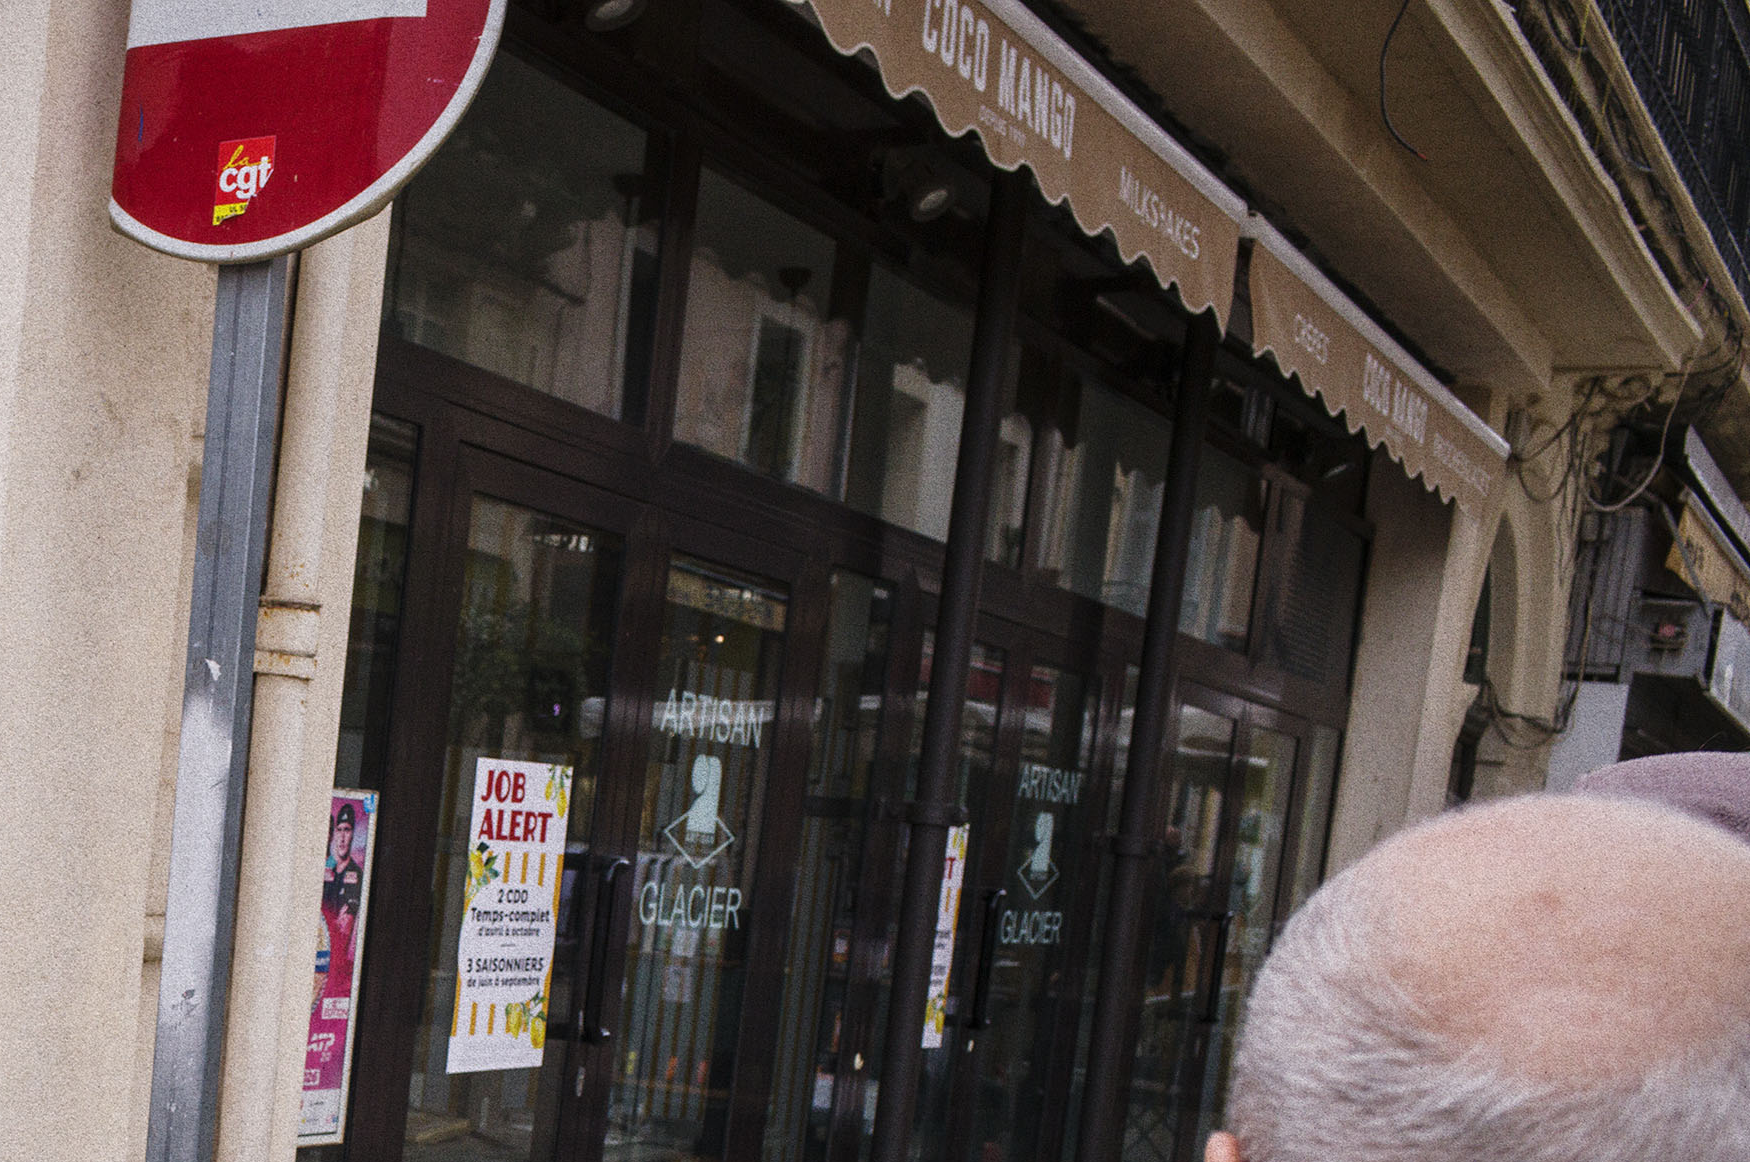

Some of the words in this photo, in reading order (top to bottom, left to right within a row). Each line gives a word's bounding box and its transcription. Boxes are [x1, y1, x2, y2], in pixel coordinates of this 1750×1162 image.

[922, 0, 990, 91] COCO
[1000, 39, 1076, 160] MANGO
[219, 156, 272, 199] cgt
[660, 688, 765, 749] ARTISAN
[480, 770, 527, 804] JOB
[1017, 760, 1083, 805] ARTISAN
[478, 808, 554, 844] ALERT
[497, 888, 504, 904] 2
[505, 889, 529, 905] CDD
[639, 881, 743, 929] GLACIER
[470, 907, 551, 925] Temps-complet
[1000, 910, 1063, 945] GLACIER
[466, 957, 474, 973] 3
[475, 956, 545, 973] SAISONNIERS
